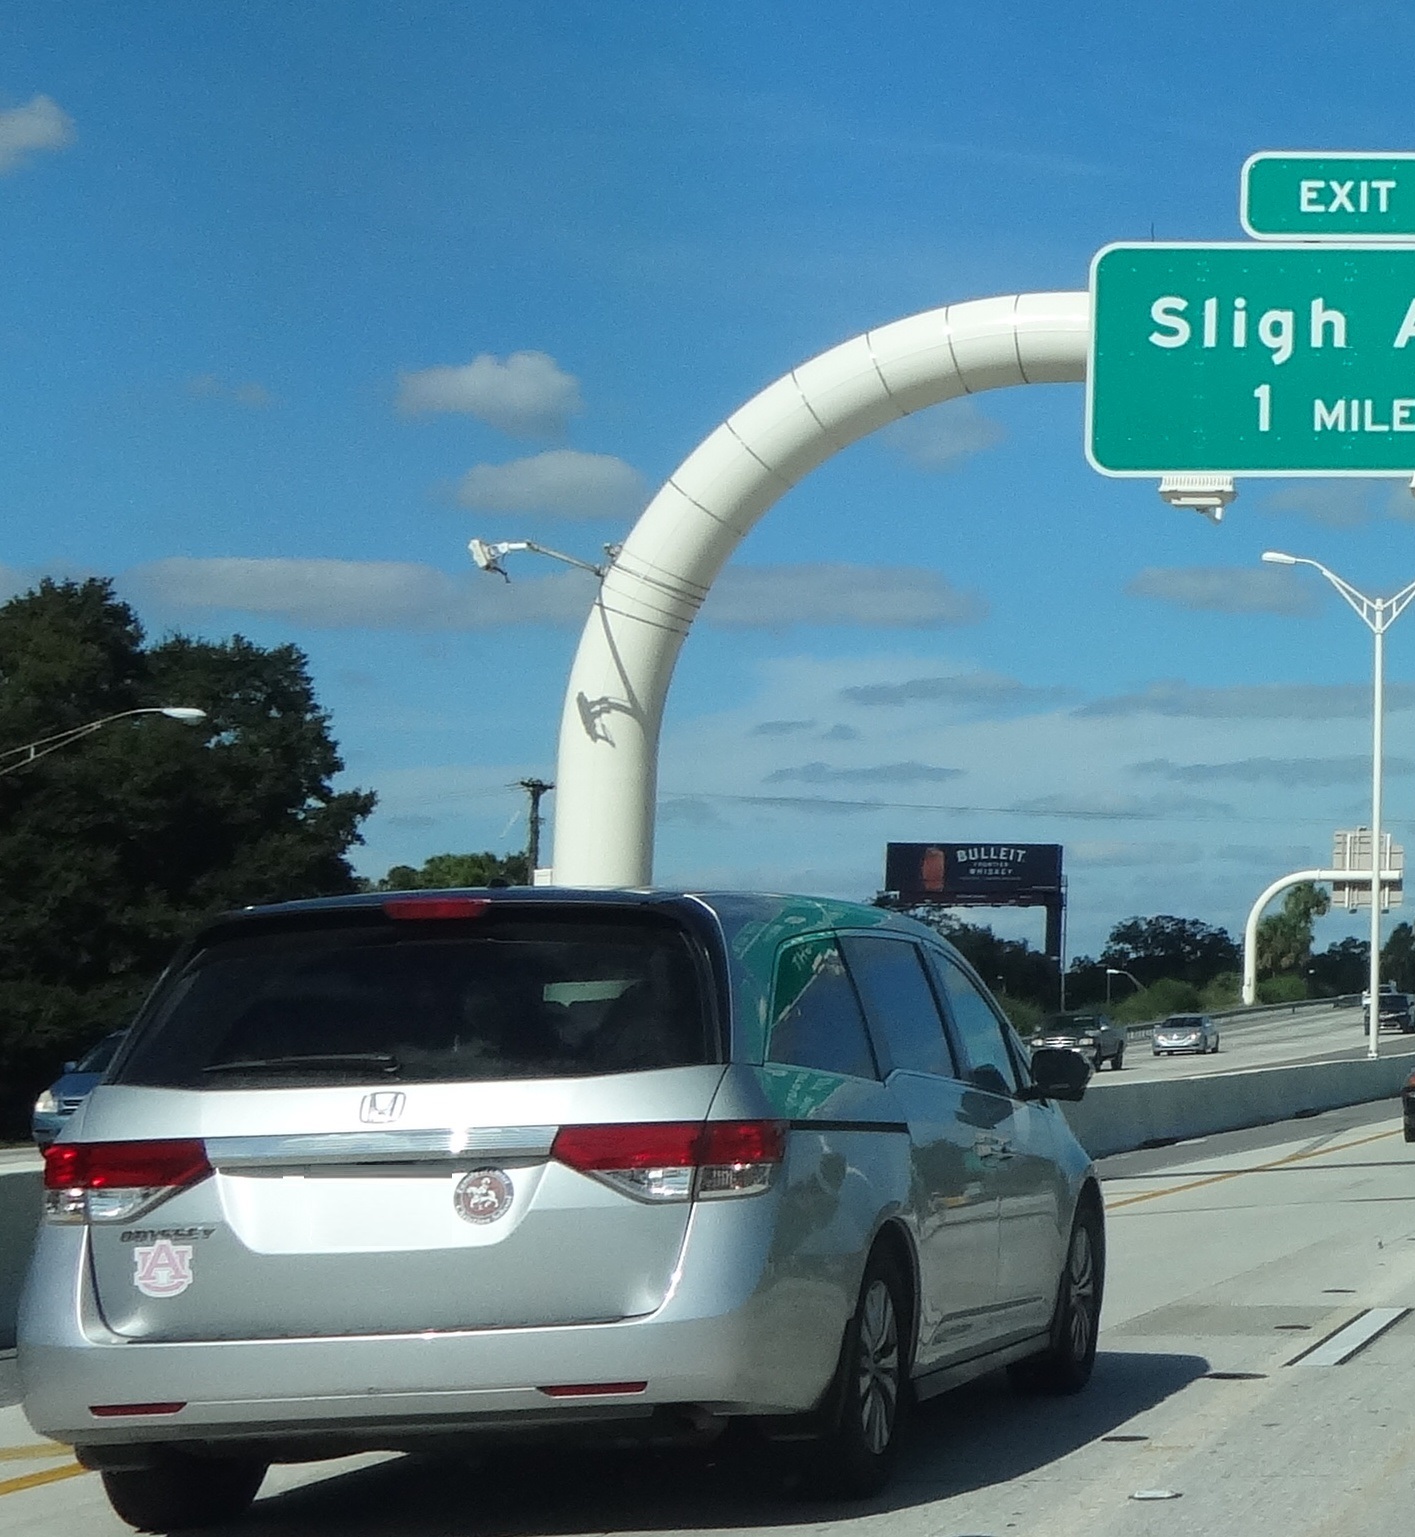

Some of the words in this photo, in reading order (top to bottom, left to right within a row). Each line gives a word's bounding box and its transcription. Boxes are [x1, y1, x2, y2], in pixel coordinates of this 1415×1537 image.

[1300, 180, 1396, 213] EXIT
[1148, 296, 1347, 365] Sligh
[1253, 384, 1271, 432] 1
[956, 847, 1026, 862] BULLEIT
